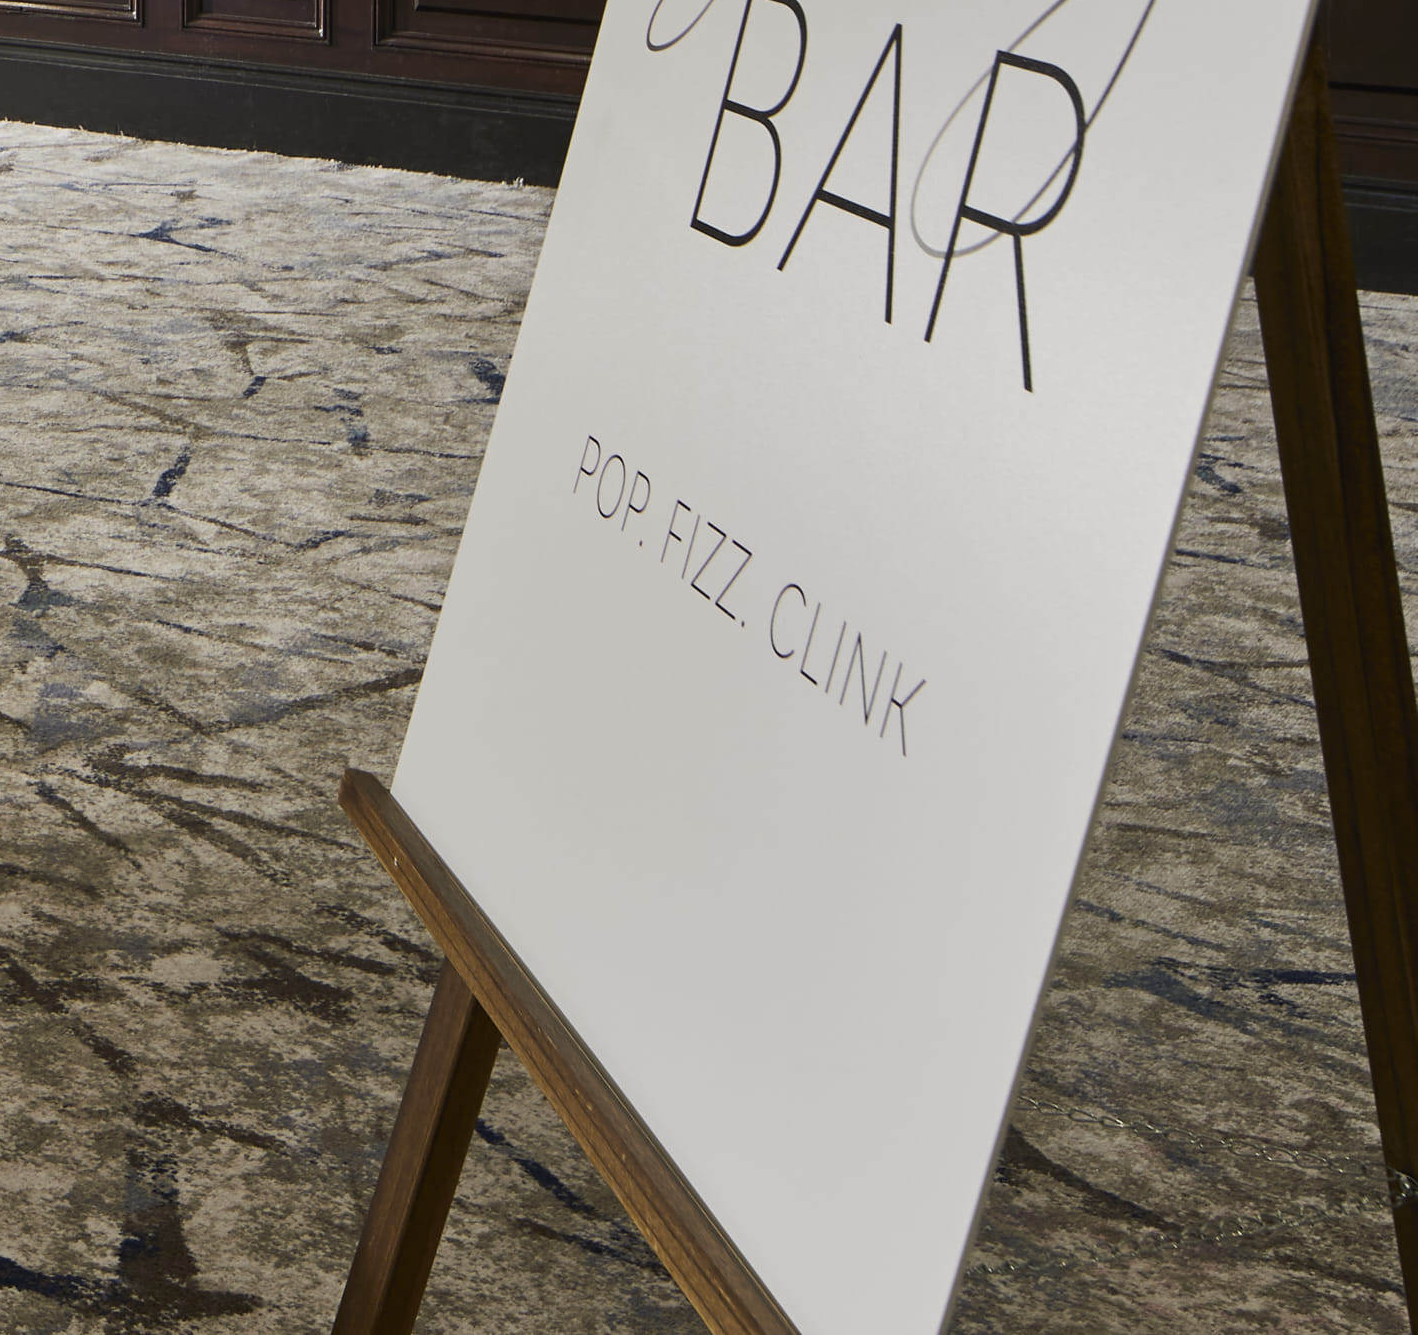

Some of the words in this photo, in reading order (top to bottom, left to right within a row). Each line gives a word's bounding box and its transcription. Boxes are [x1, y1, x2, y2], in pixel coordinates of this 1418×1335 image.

[573, 434, 651, 547] POP.
[660, 499, 753, 628] FIZZ.
[769, 582, 927, 757] CLINK
